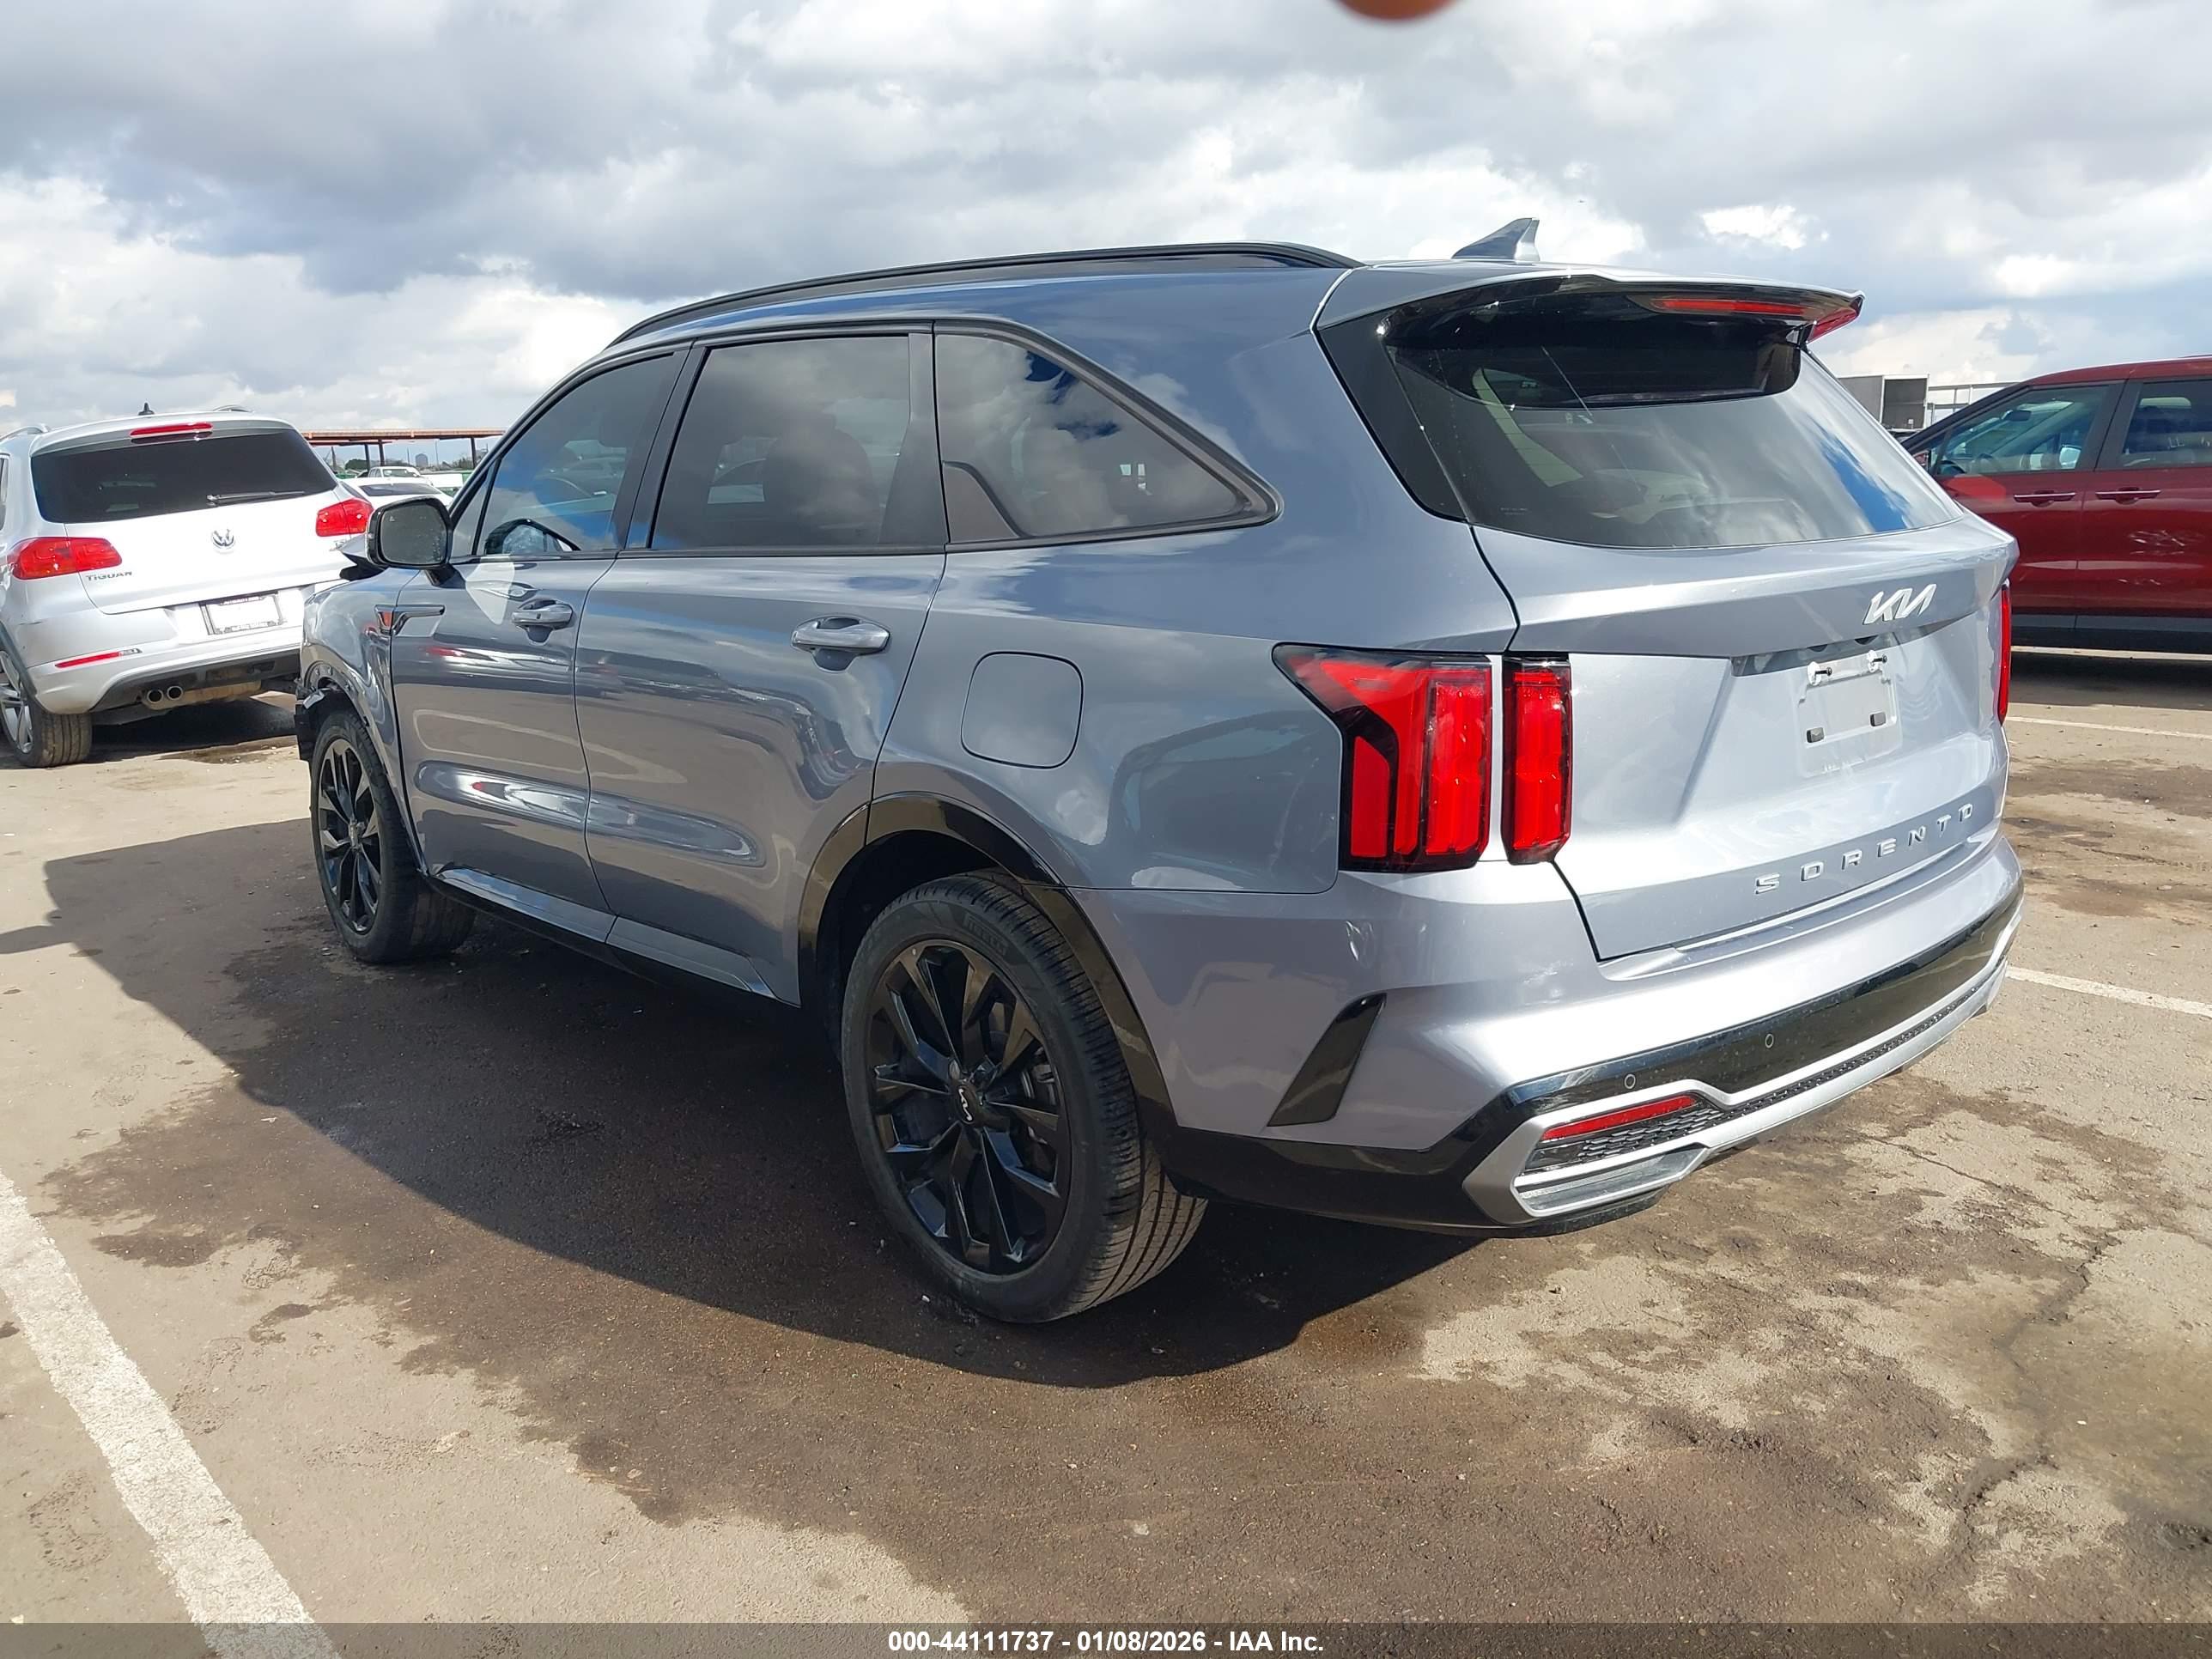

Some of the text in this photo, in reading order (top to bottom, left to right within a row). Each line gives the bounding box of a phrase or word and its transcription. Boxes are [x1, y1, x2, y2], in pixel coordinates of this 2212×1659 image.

[86, 571, 133, 581] TIGUAN
[1862, 583, 1937, 625] KIA
[1753, 803, 1974, 895] SORENTO
